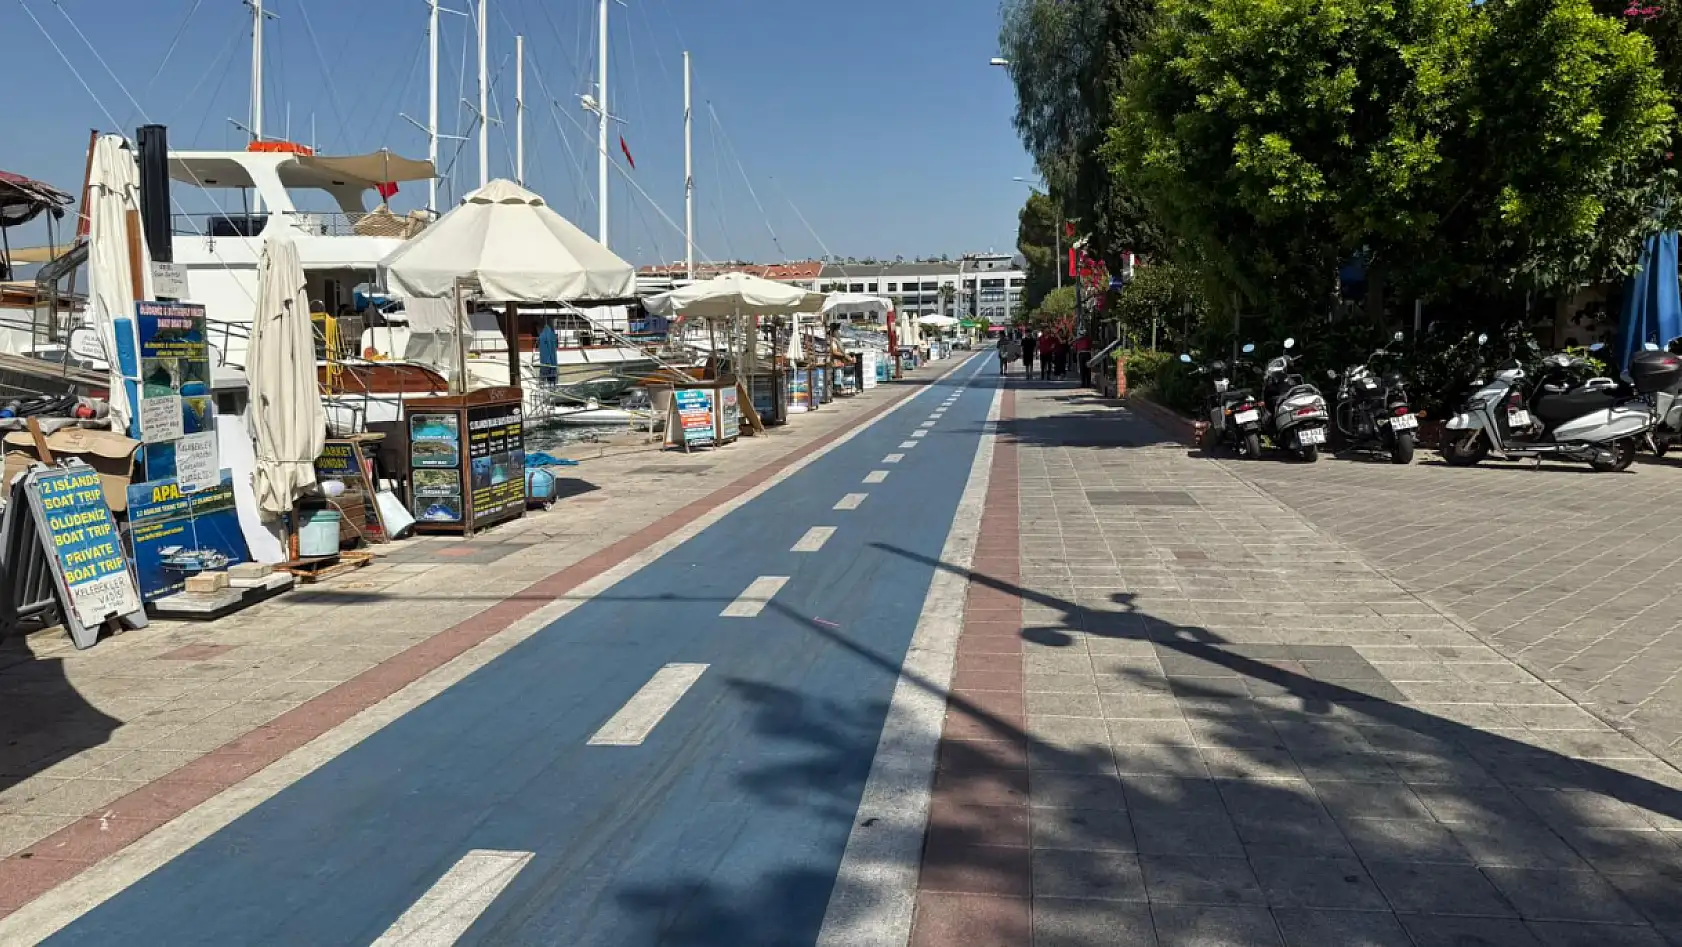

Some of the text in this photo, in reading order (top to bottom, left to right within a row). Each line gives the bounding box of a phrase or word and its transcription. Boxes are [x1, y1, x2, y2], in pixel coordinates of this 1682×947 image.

[53, 474, 101, 491] ISLANDS
[44, 489, 101, 510] BOAT TRIP
[54, 524, 111, 546] BOAT TRIP
[65, 543, 114, 566] PRIVATE
[66, 557, 124, 584] BOAT TRIP
